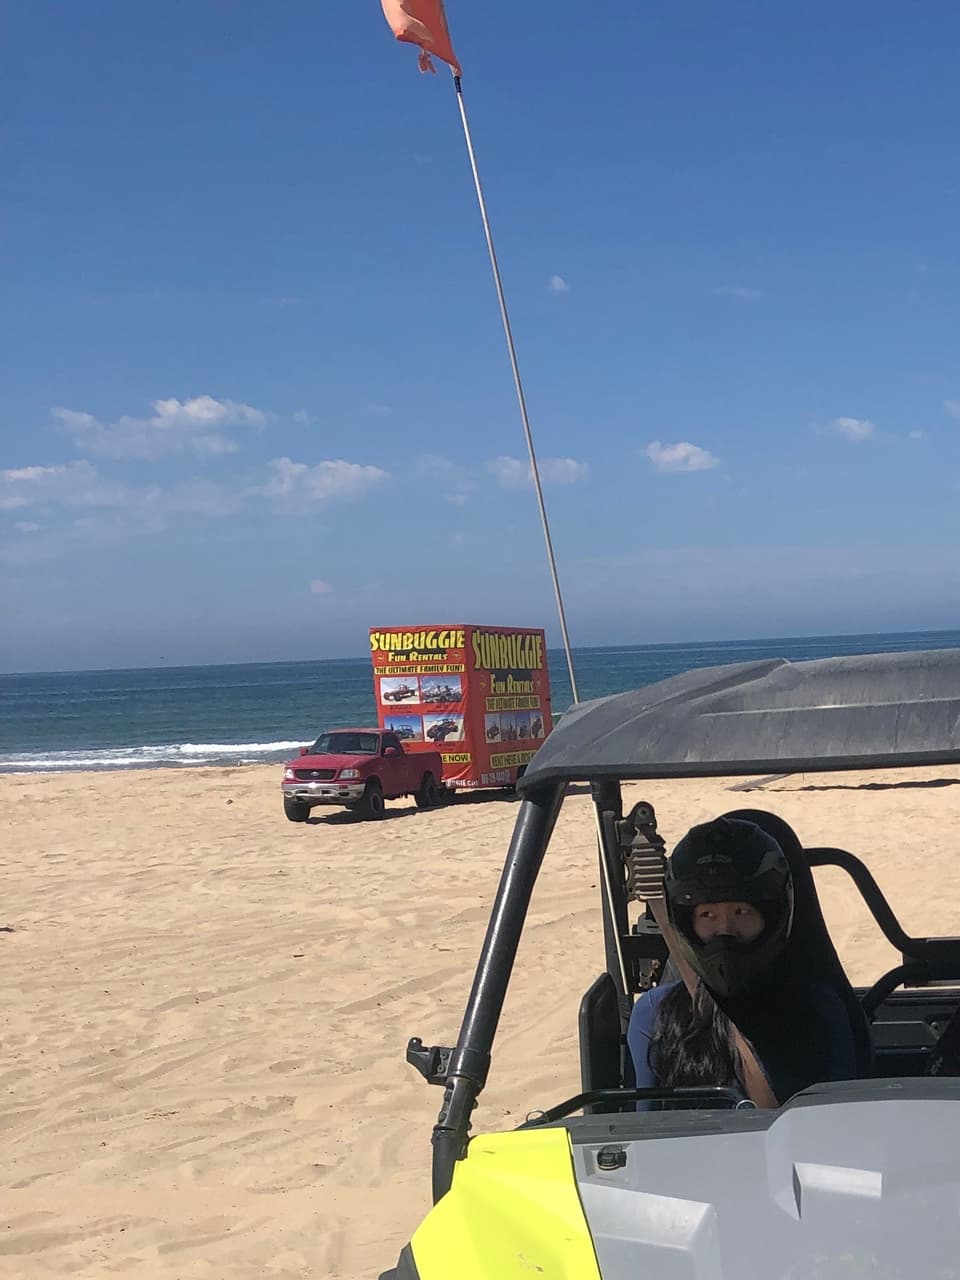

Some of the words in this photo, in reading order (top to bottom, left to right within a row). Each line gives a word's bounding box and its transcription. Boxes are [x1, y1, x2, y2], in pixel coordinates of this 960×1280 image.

[370, 630, 465, 651] SUNBUGGIE
[472, 629, 543, 669] SUNBUGGIE
[449, 754, 469, 762] NOW
